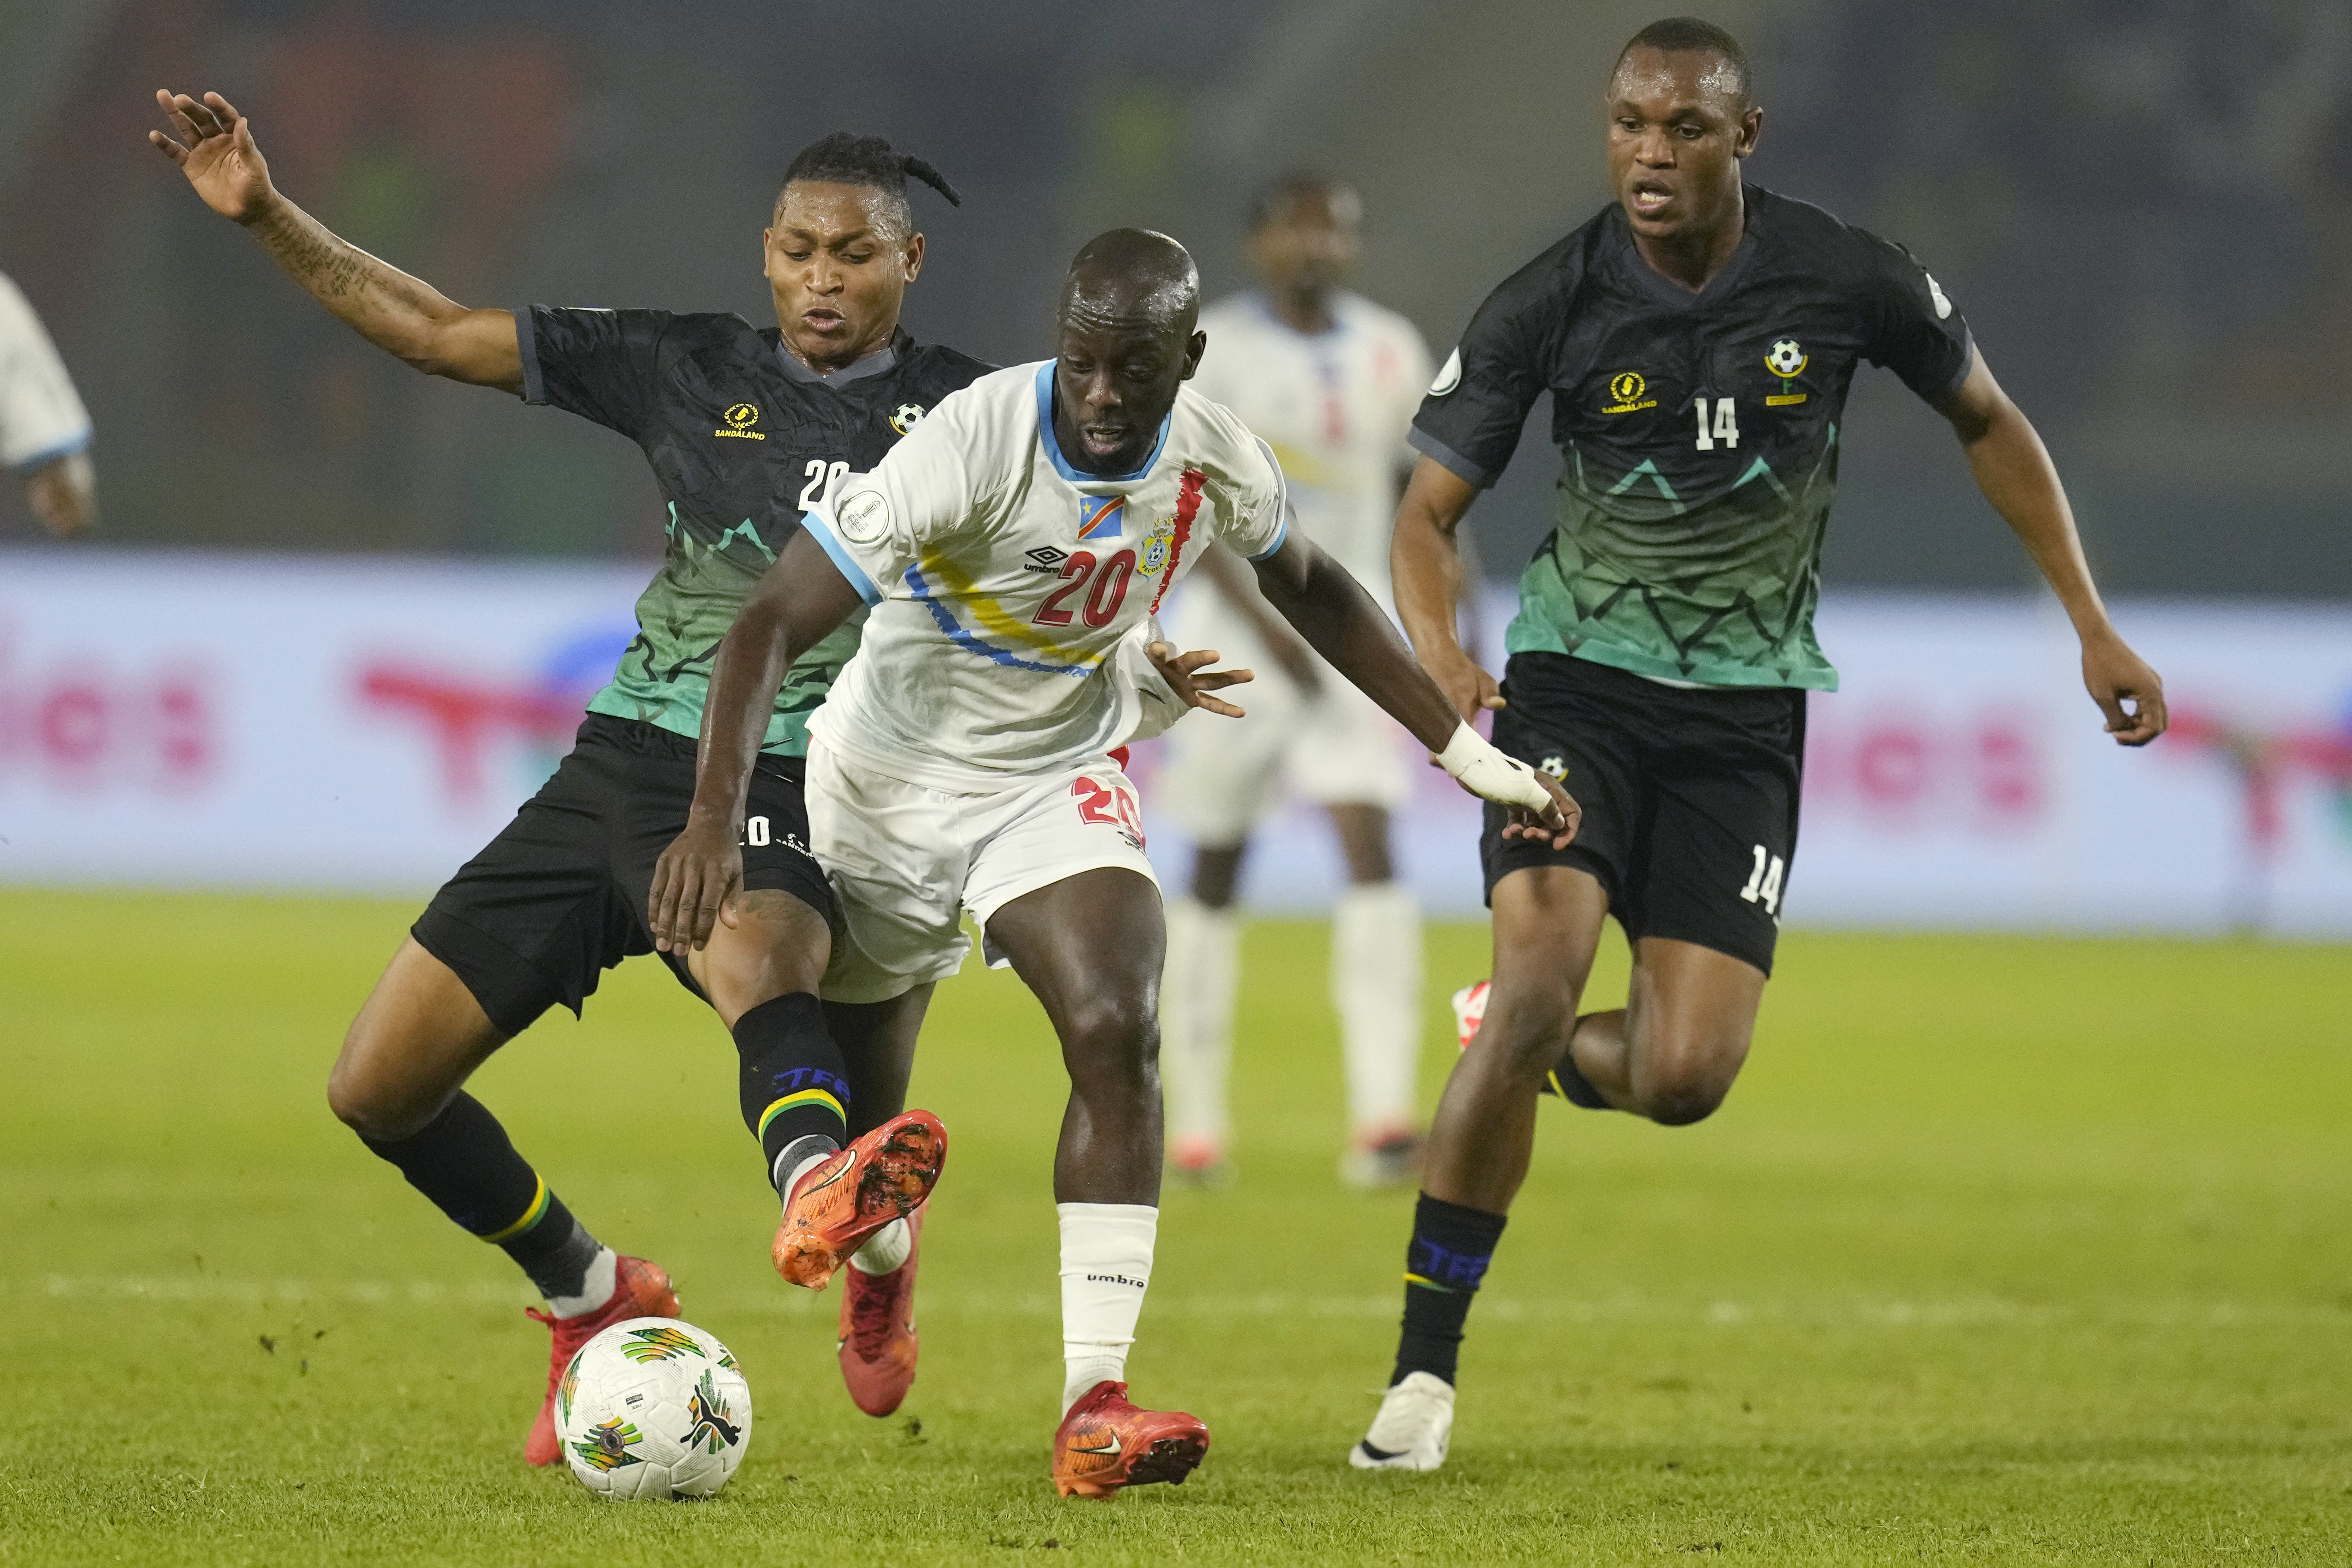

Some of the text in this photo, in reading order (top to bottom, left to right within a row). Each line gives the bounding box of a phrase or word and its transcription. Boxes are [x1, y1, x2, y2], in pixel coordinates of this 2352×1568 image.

[715, 430, 765, 440] SANDALAND
[1694, 397, 1740, 451] 14
[1024, 564, 1060, 573] umbro
[1142, 563, 1164, 573] FECOFA
[1031, 549, 1136, 628] 20
[1071, 776, 1146, 849] 20
[738, 816, 770, 846] 0
[1740, 844, 1783, 915] 14
[1087, 1274, 1144, 1288] umbro
